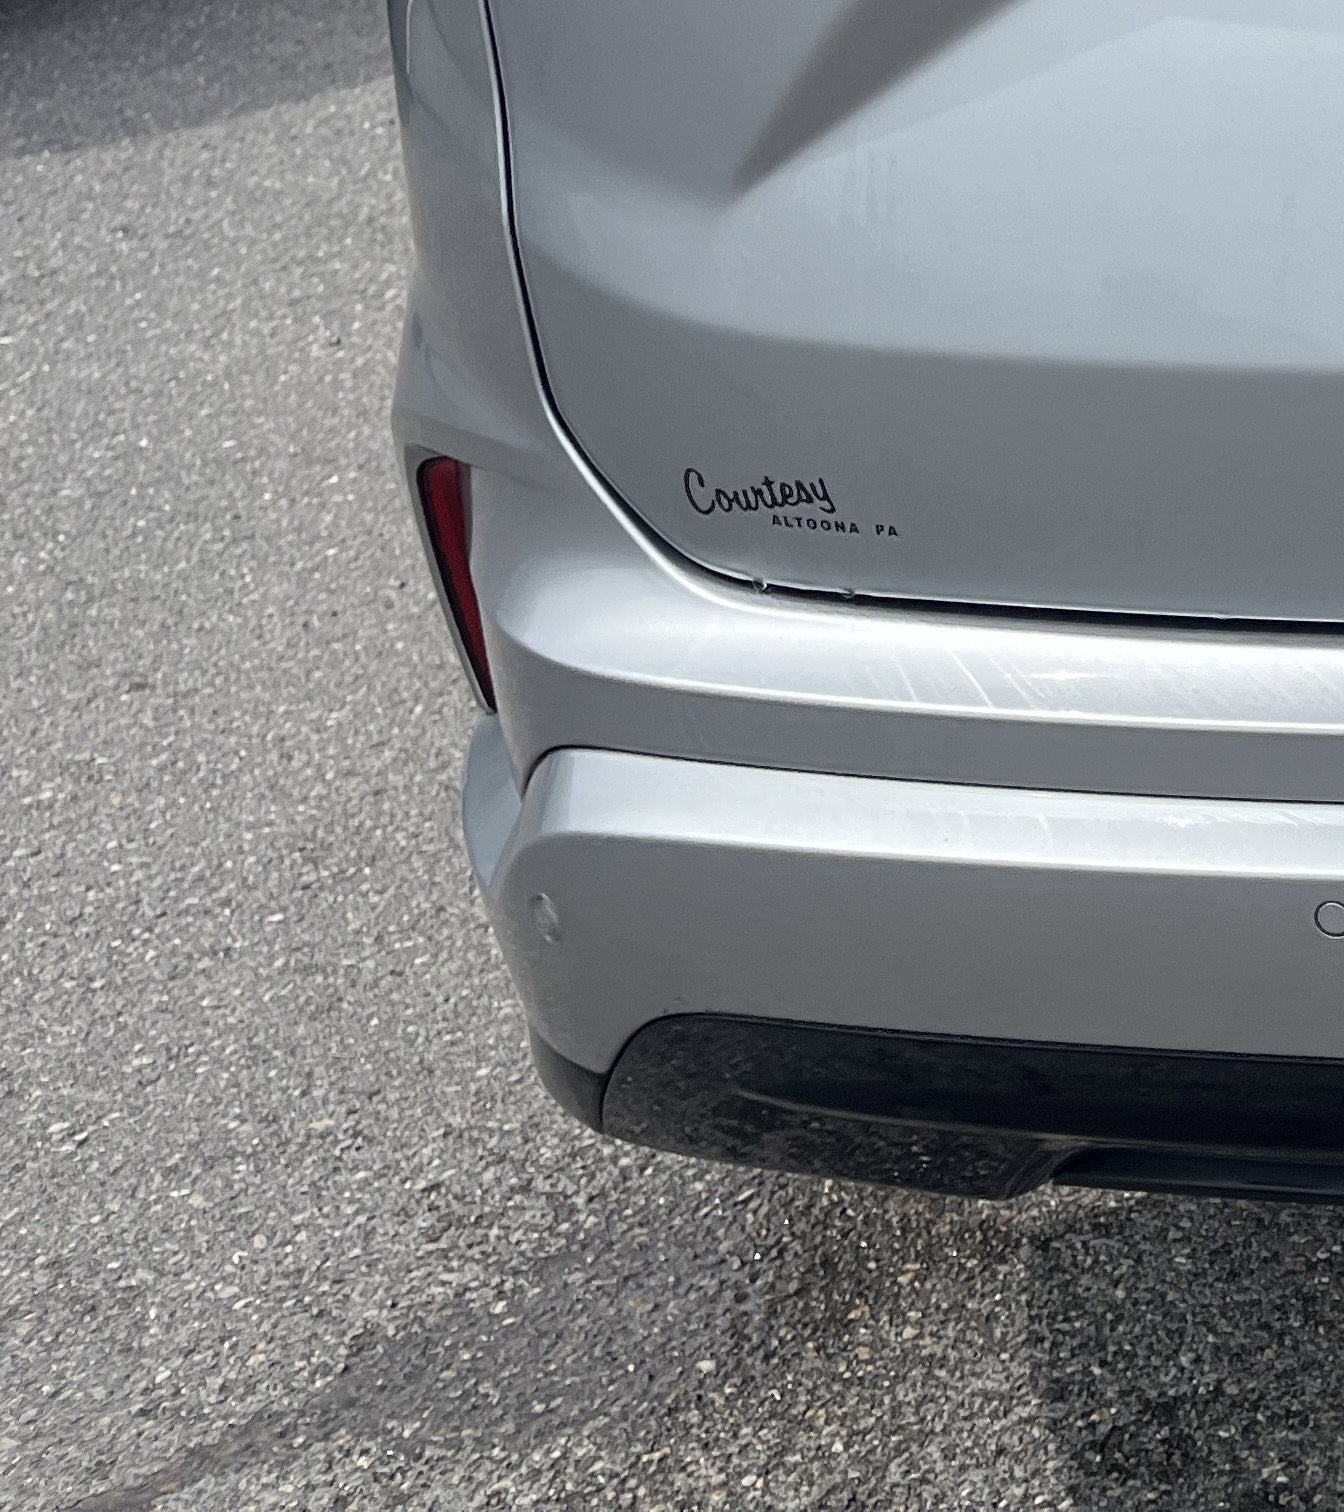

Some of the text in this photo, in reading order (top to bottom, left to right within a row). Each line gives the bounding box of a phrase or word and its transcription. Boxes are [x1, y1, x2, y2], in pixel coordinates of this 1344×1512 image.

[683, 467, 837, 515] Courtesy
[772, 514, 899, 537] ALTOONA PA
